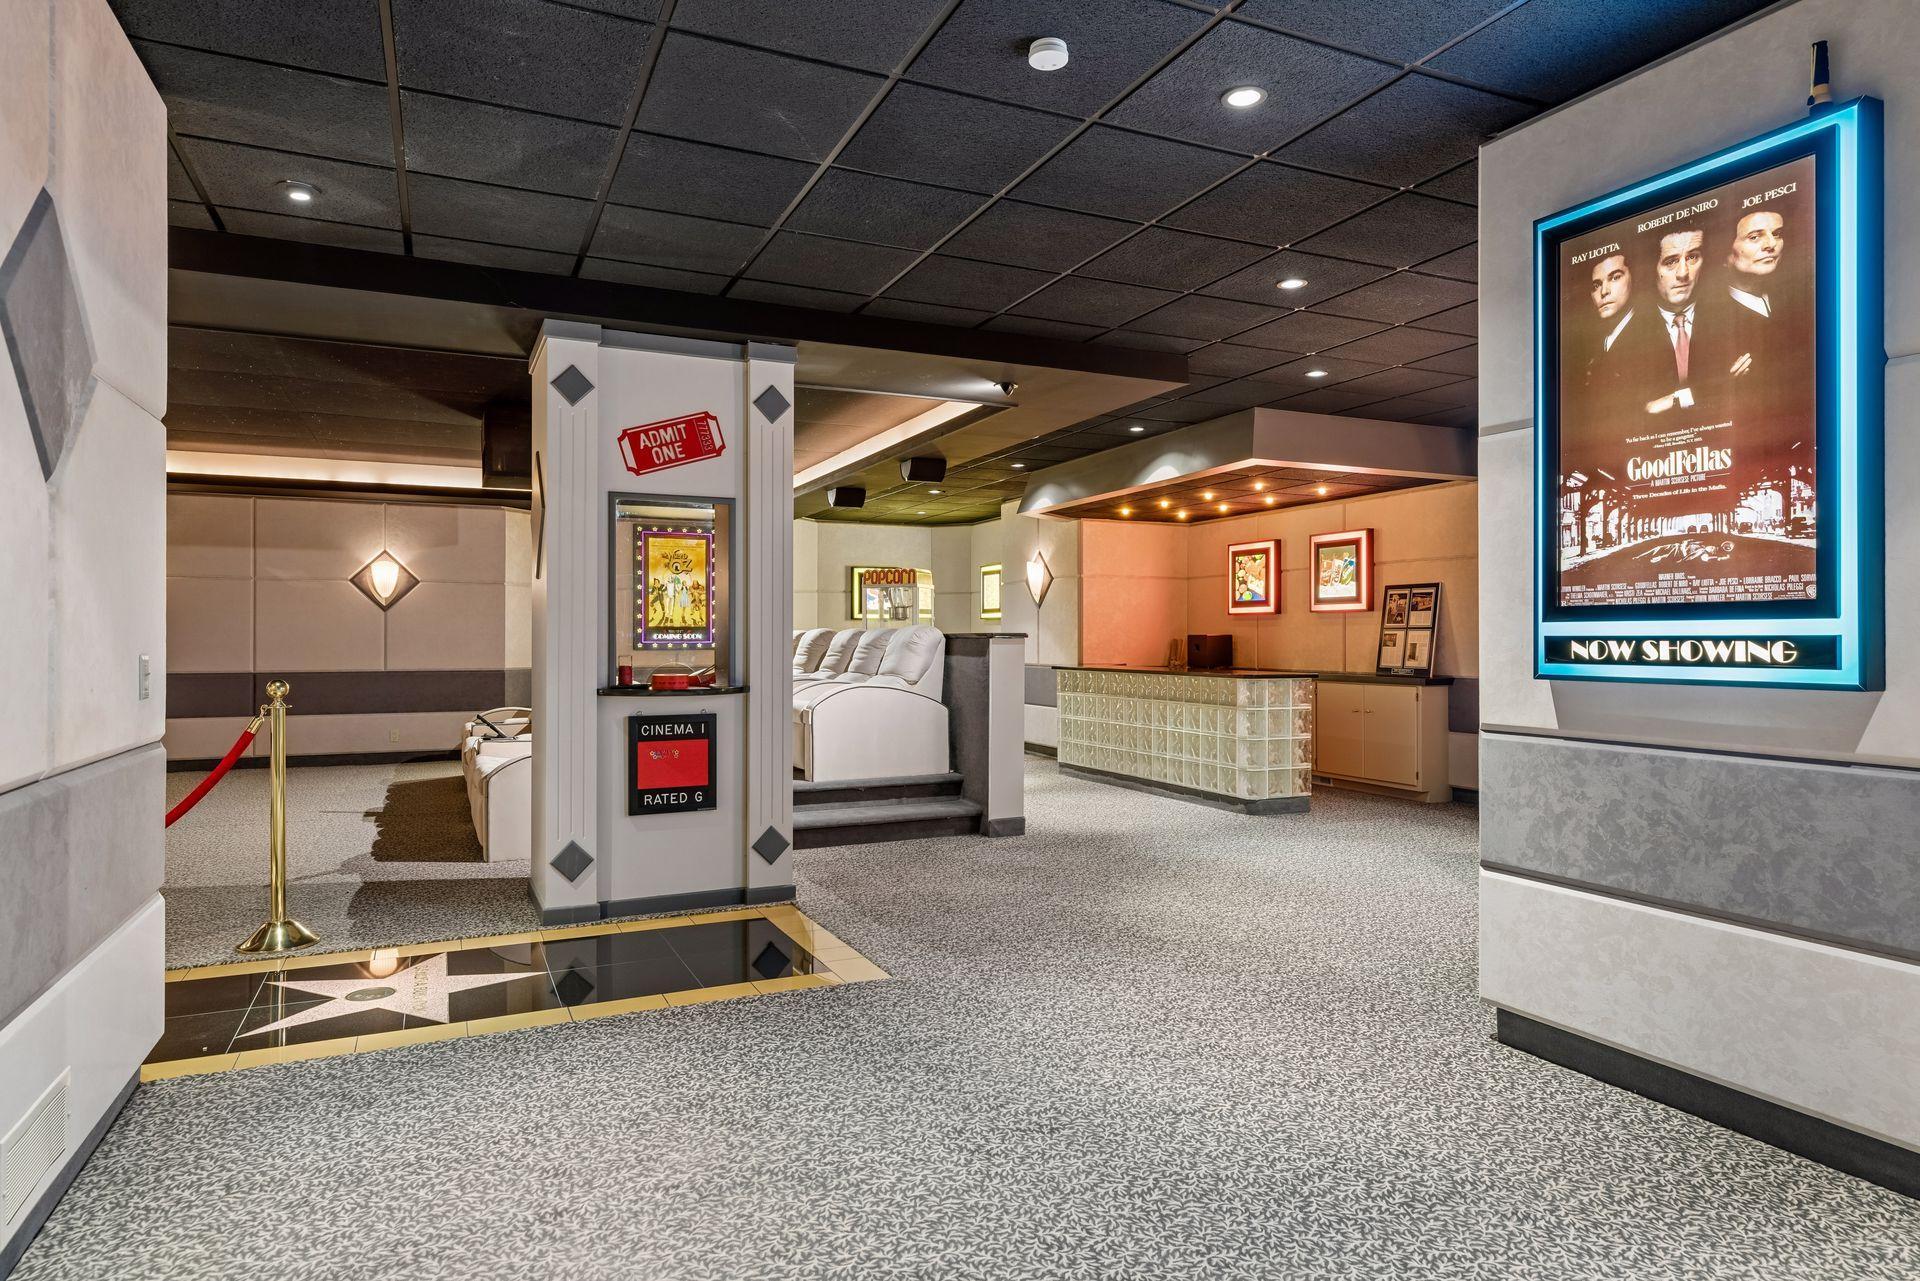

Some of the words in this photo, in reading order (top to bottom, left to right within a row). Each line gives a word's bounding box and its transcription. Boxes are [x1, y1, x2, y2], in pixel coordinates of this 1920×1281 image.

[1742, 194, 1762, 208] JOE
[1764, 182, 1796, 201] PESCI
[1637, 214, 1674, 234] ROBERT
[1676, 208, 1690, 220] DE
[1691, 198, 1718, 215] NIRO
[1572, 252, 1588, 264] RAY
[1588, 242, 1620, 259] LIOTTA
[640, 424, 686, 450] ADMIT
[698, 420, 714, 450] 777333
[652, 442, 686, 464] ONE
[1627, 446, 1732, 481] GoodFellas
[1570, 640, 1636, 661] NOW
[1642, 640, 1798, 663] SHOWING
[641, 723, 694, 736] CINEMA
[644, 792, 688, 806] RATED
[695, 792, 703, 802] G
